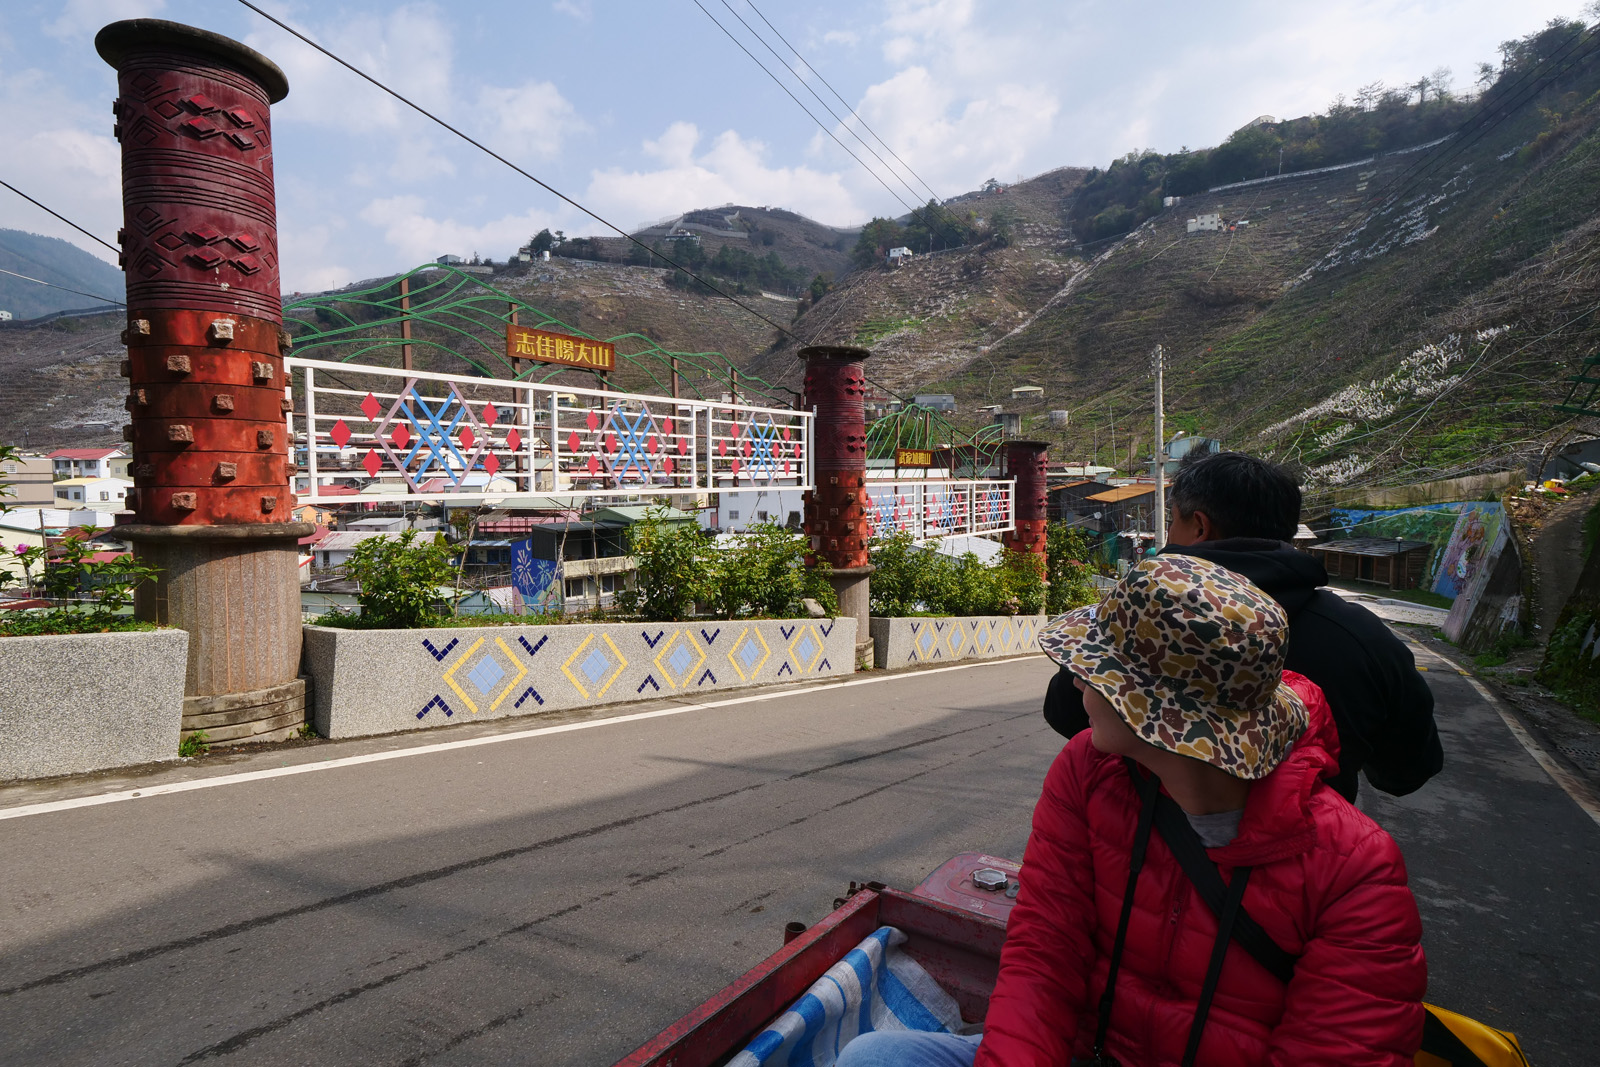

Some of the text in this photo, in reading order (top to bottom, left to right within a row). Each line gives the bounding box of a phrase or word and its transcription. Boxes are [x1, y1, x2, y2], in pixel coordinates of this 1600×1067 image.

[515, 332, 609, 367] 志佳陽大山
